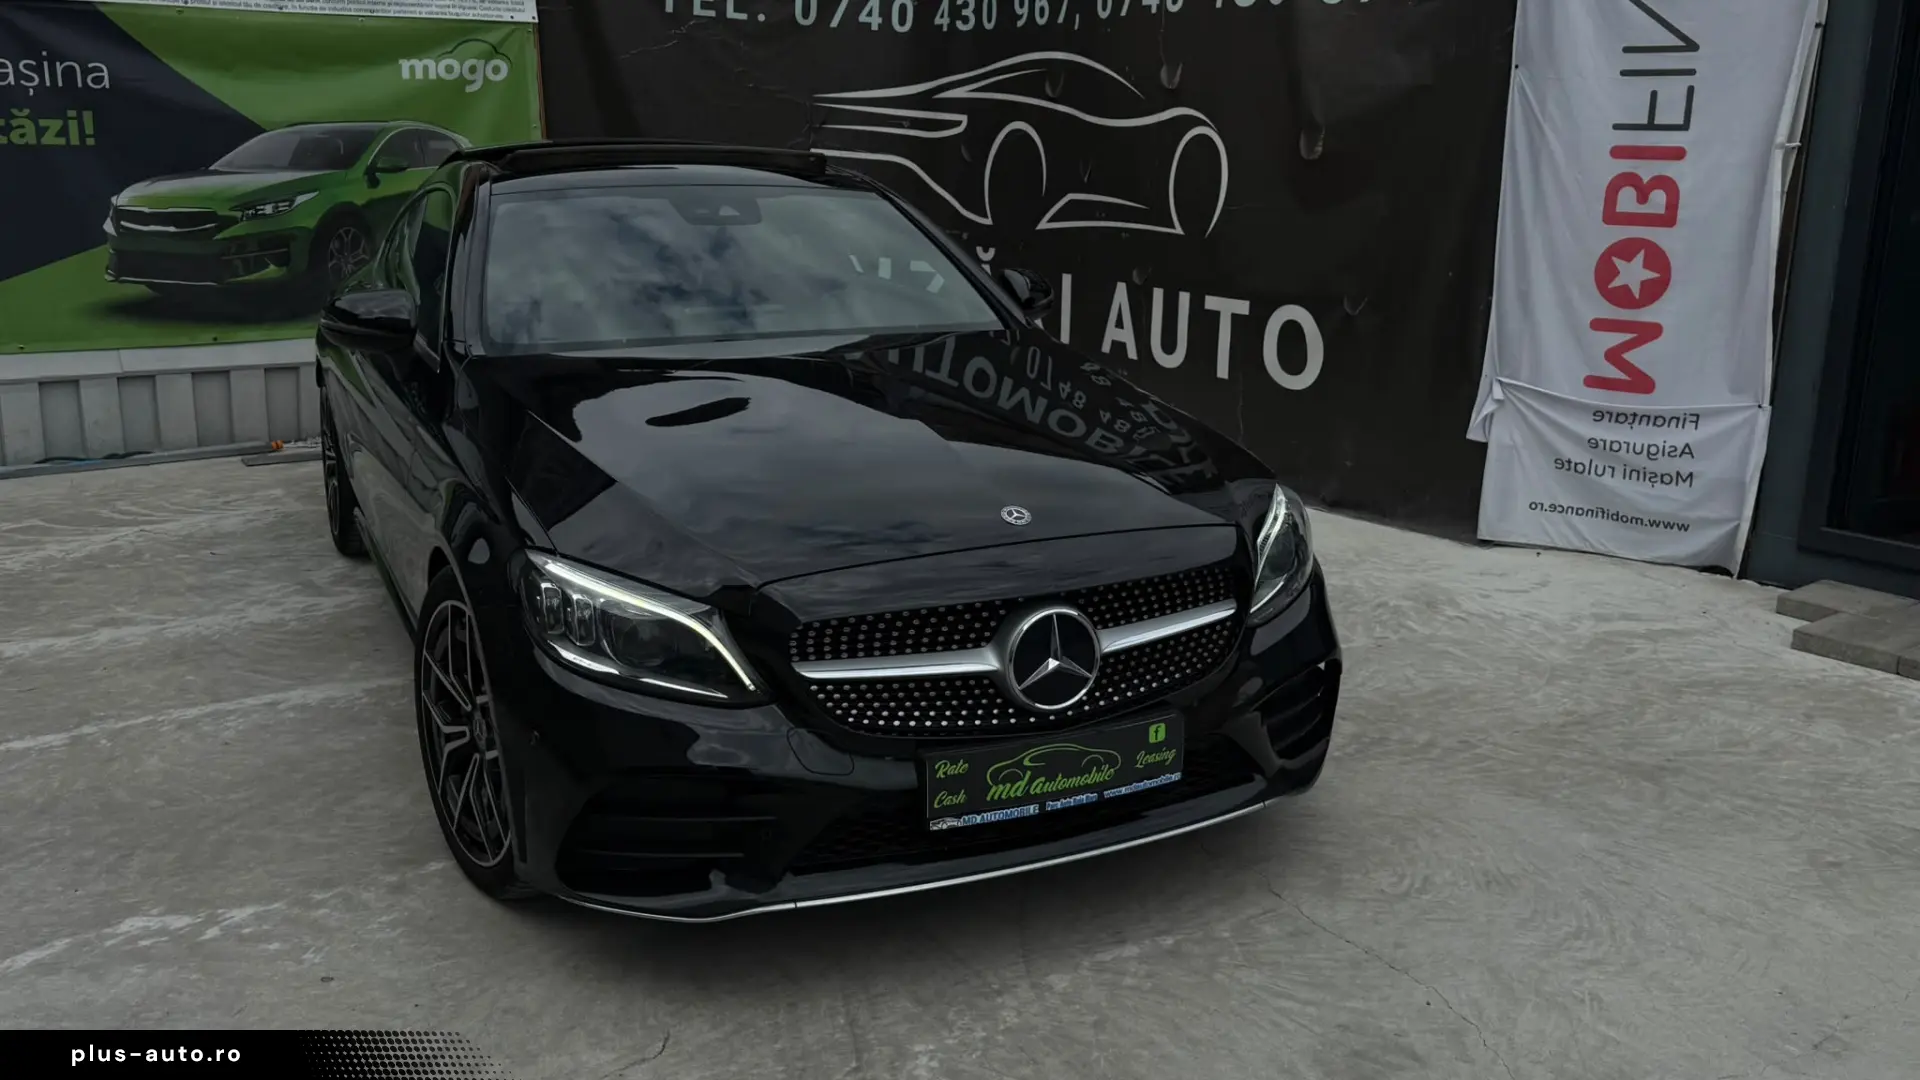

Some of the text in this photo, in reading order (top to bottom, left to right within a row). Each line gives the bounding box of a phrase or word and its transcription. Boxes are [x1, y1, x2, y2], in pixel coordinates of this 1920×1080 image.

[934, 0, 998, 31] 430
[399, 55, 510, 92] mogo
[1101, 281, 1325, 391] AUTO
[935, 759, 969, 779] Rate
[1135, 747, 1177, 769] Leasing
[934, 789, 967, 809] Cash
[961, 804, 1040, 827] MD AUTOMOBILE
